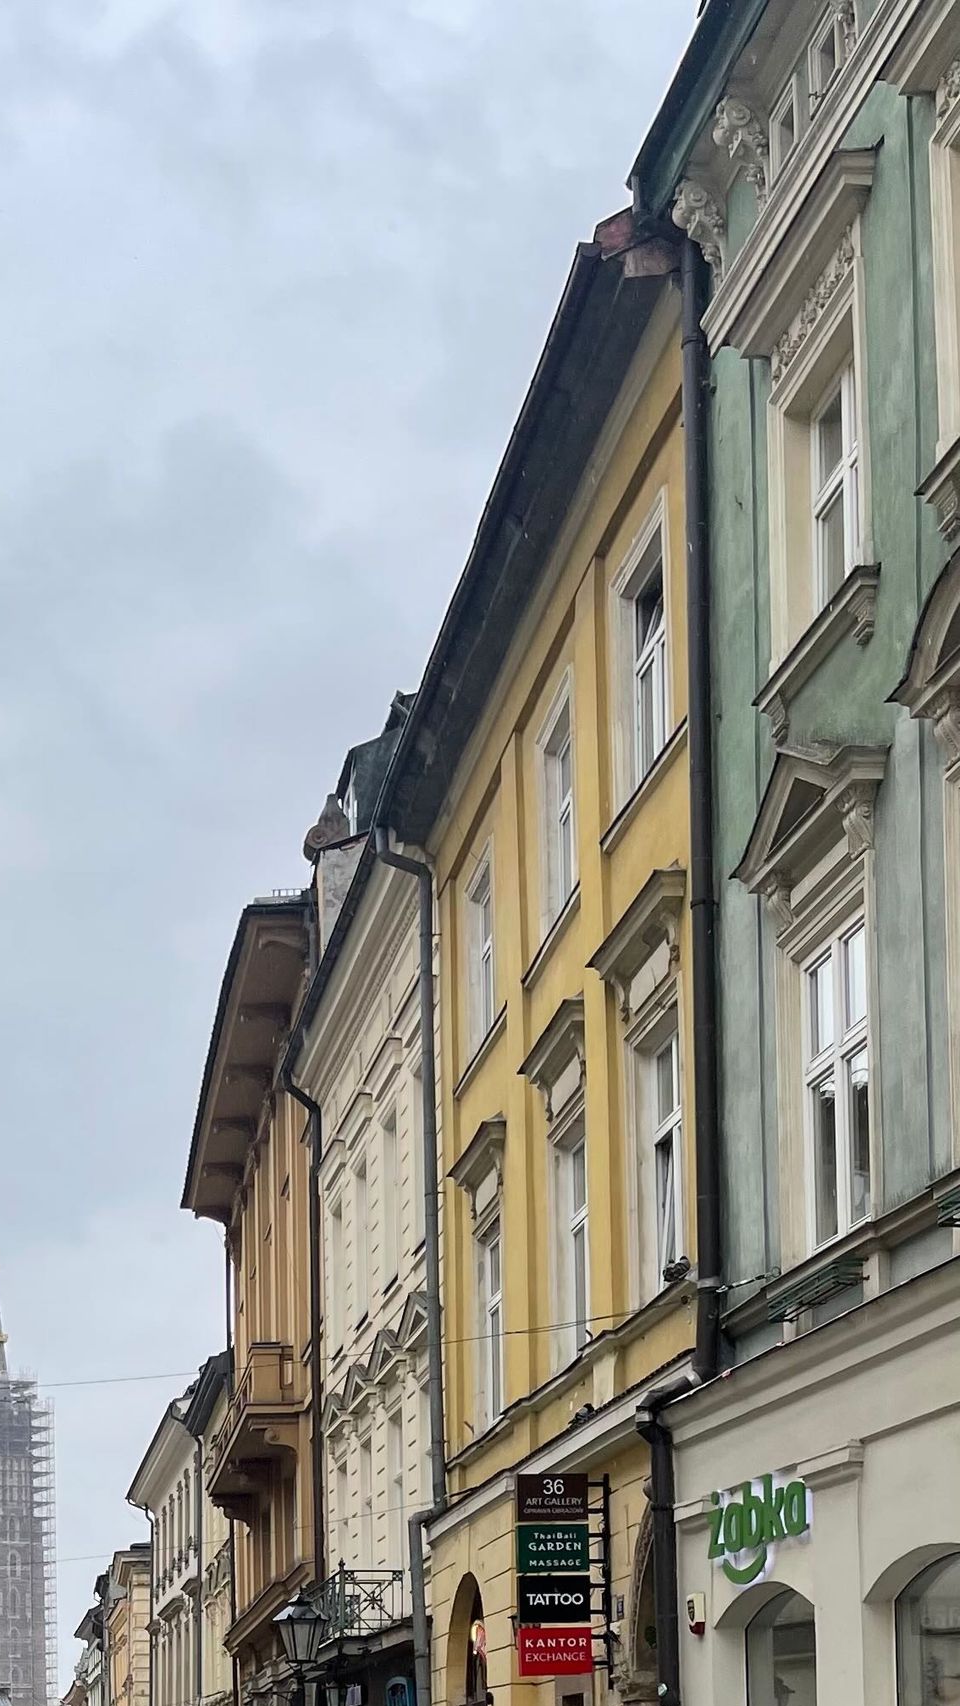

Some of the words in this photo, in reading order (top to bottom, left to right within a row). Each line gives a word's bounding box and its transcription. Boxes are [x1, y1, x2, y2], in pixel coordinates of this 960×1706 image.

[543, 1479, 564, 1495] 36
[544, 1498, 582, 1506] GALLERY
[528, 1542, 582, 1551] GARDEN
[529, 1559, 581, 1567] MASSAGE
[526, 1593, 584, 1606] TATTOO
[525, 1638, 587, 1648] KANTOR
[525, 1652, 586, 1662] EXCHANGE
